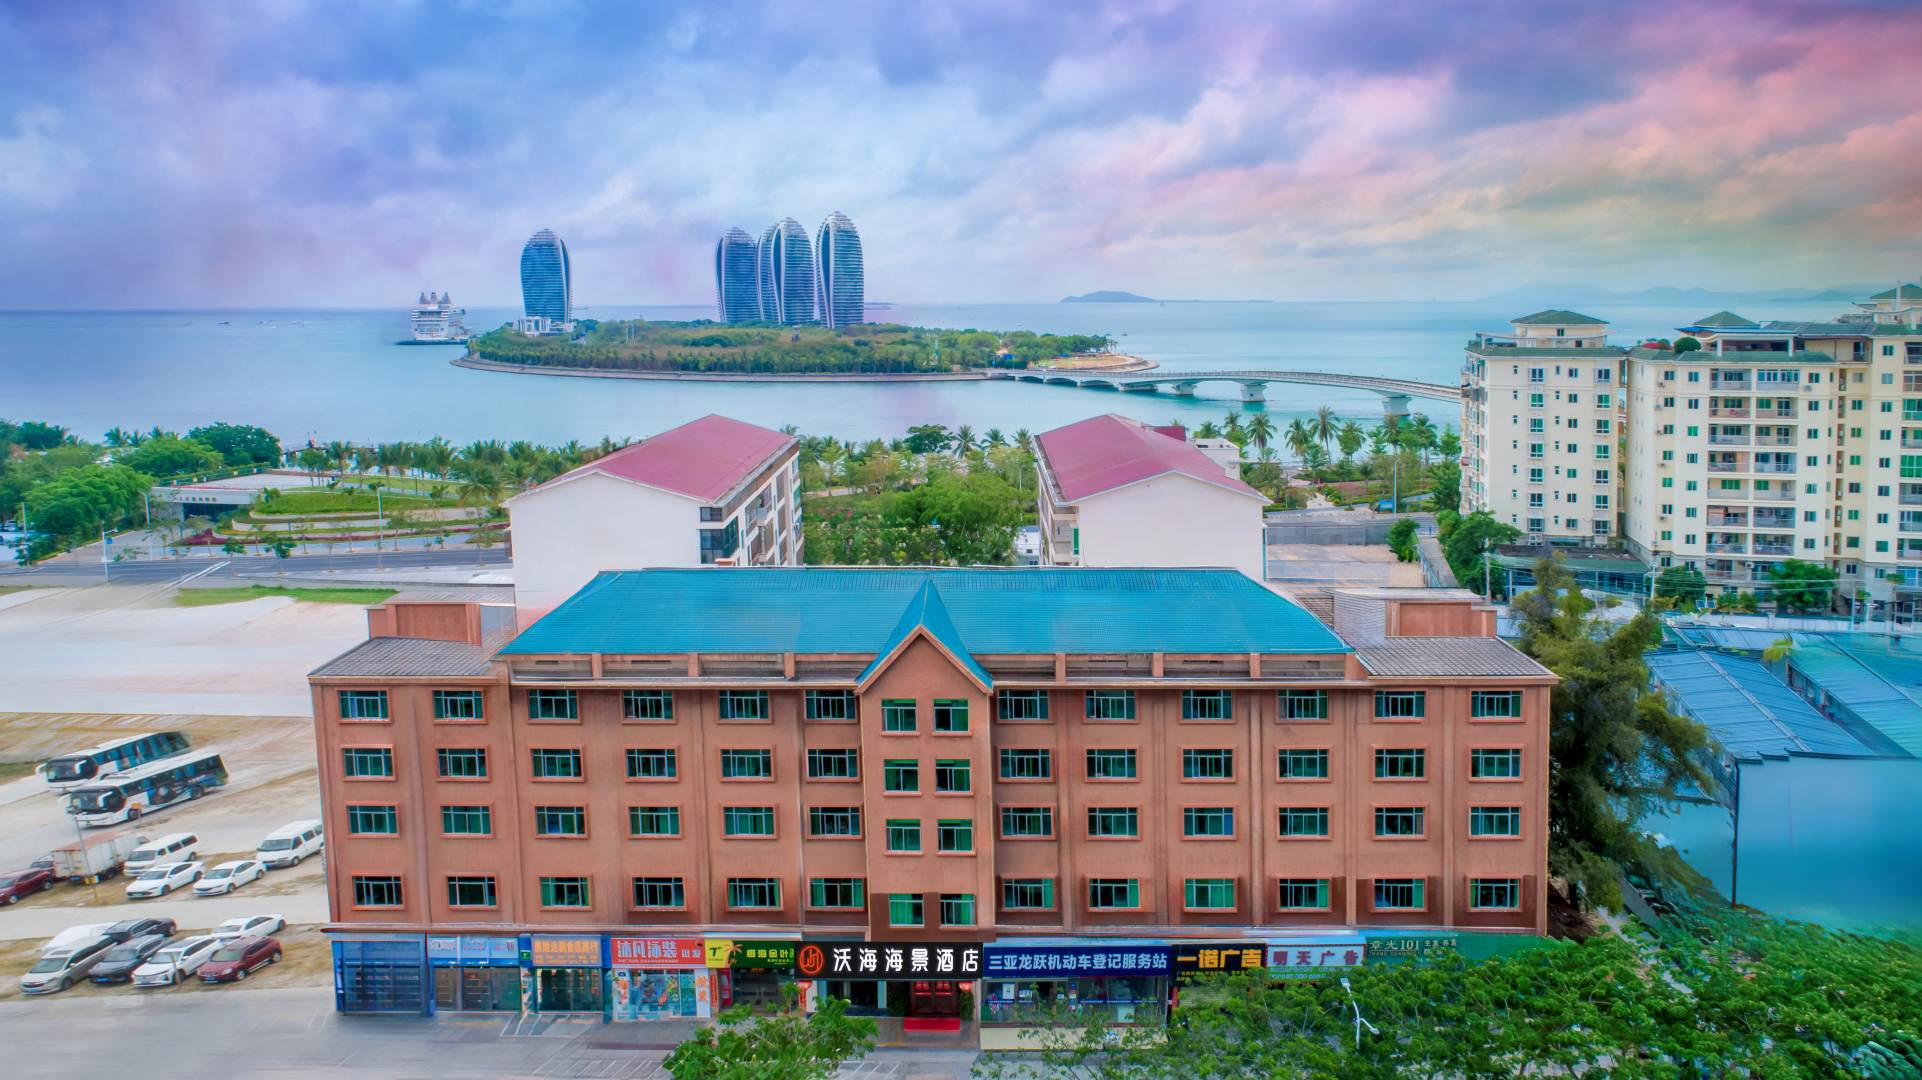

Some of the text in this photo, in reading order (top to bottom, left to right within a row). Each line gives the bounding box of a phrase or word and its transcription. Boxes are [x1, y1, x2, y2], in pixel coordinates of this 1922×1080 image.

[833, 948, 979, 972] 沃海海景酒店
[989, 953, 1168, 970] 三亚龙跃机动车登记服务站
[1177, 949, 1262, 969] 一诺广告
